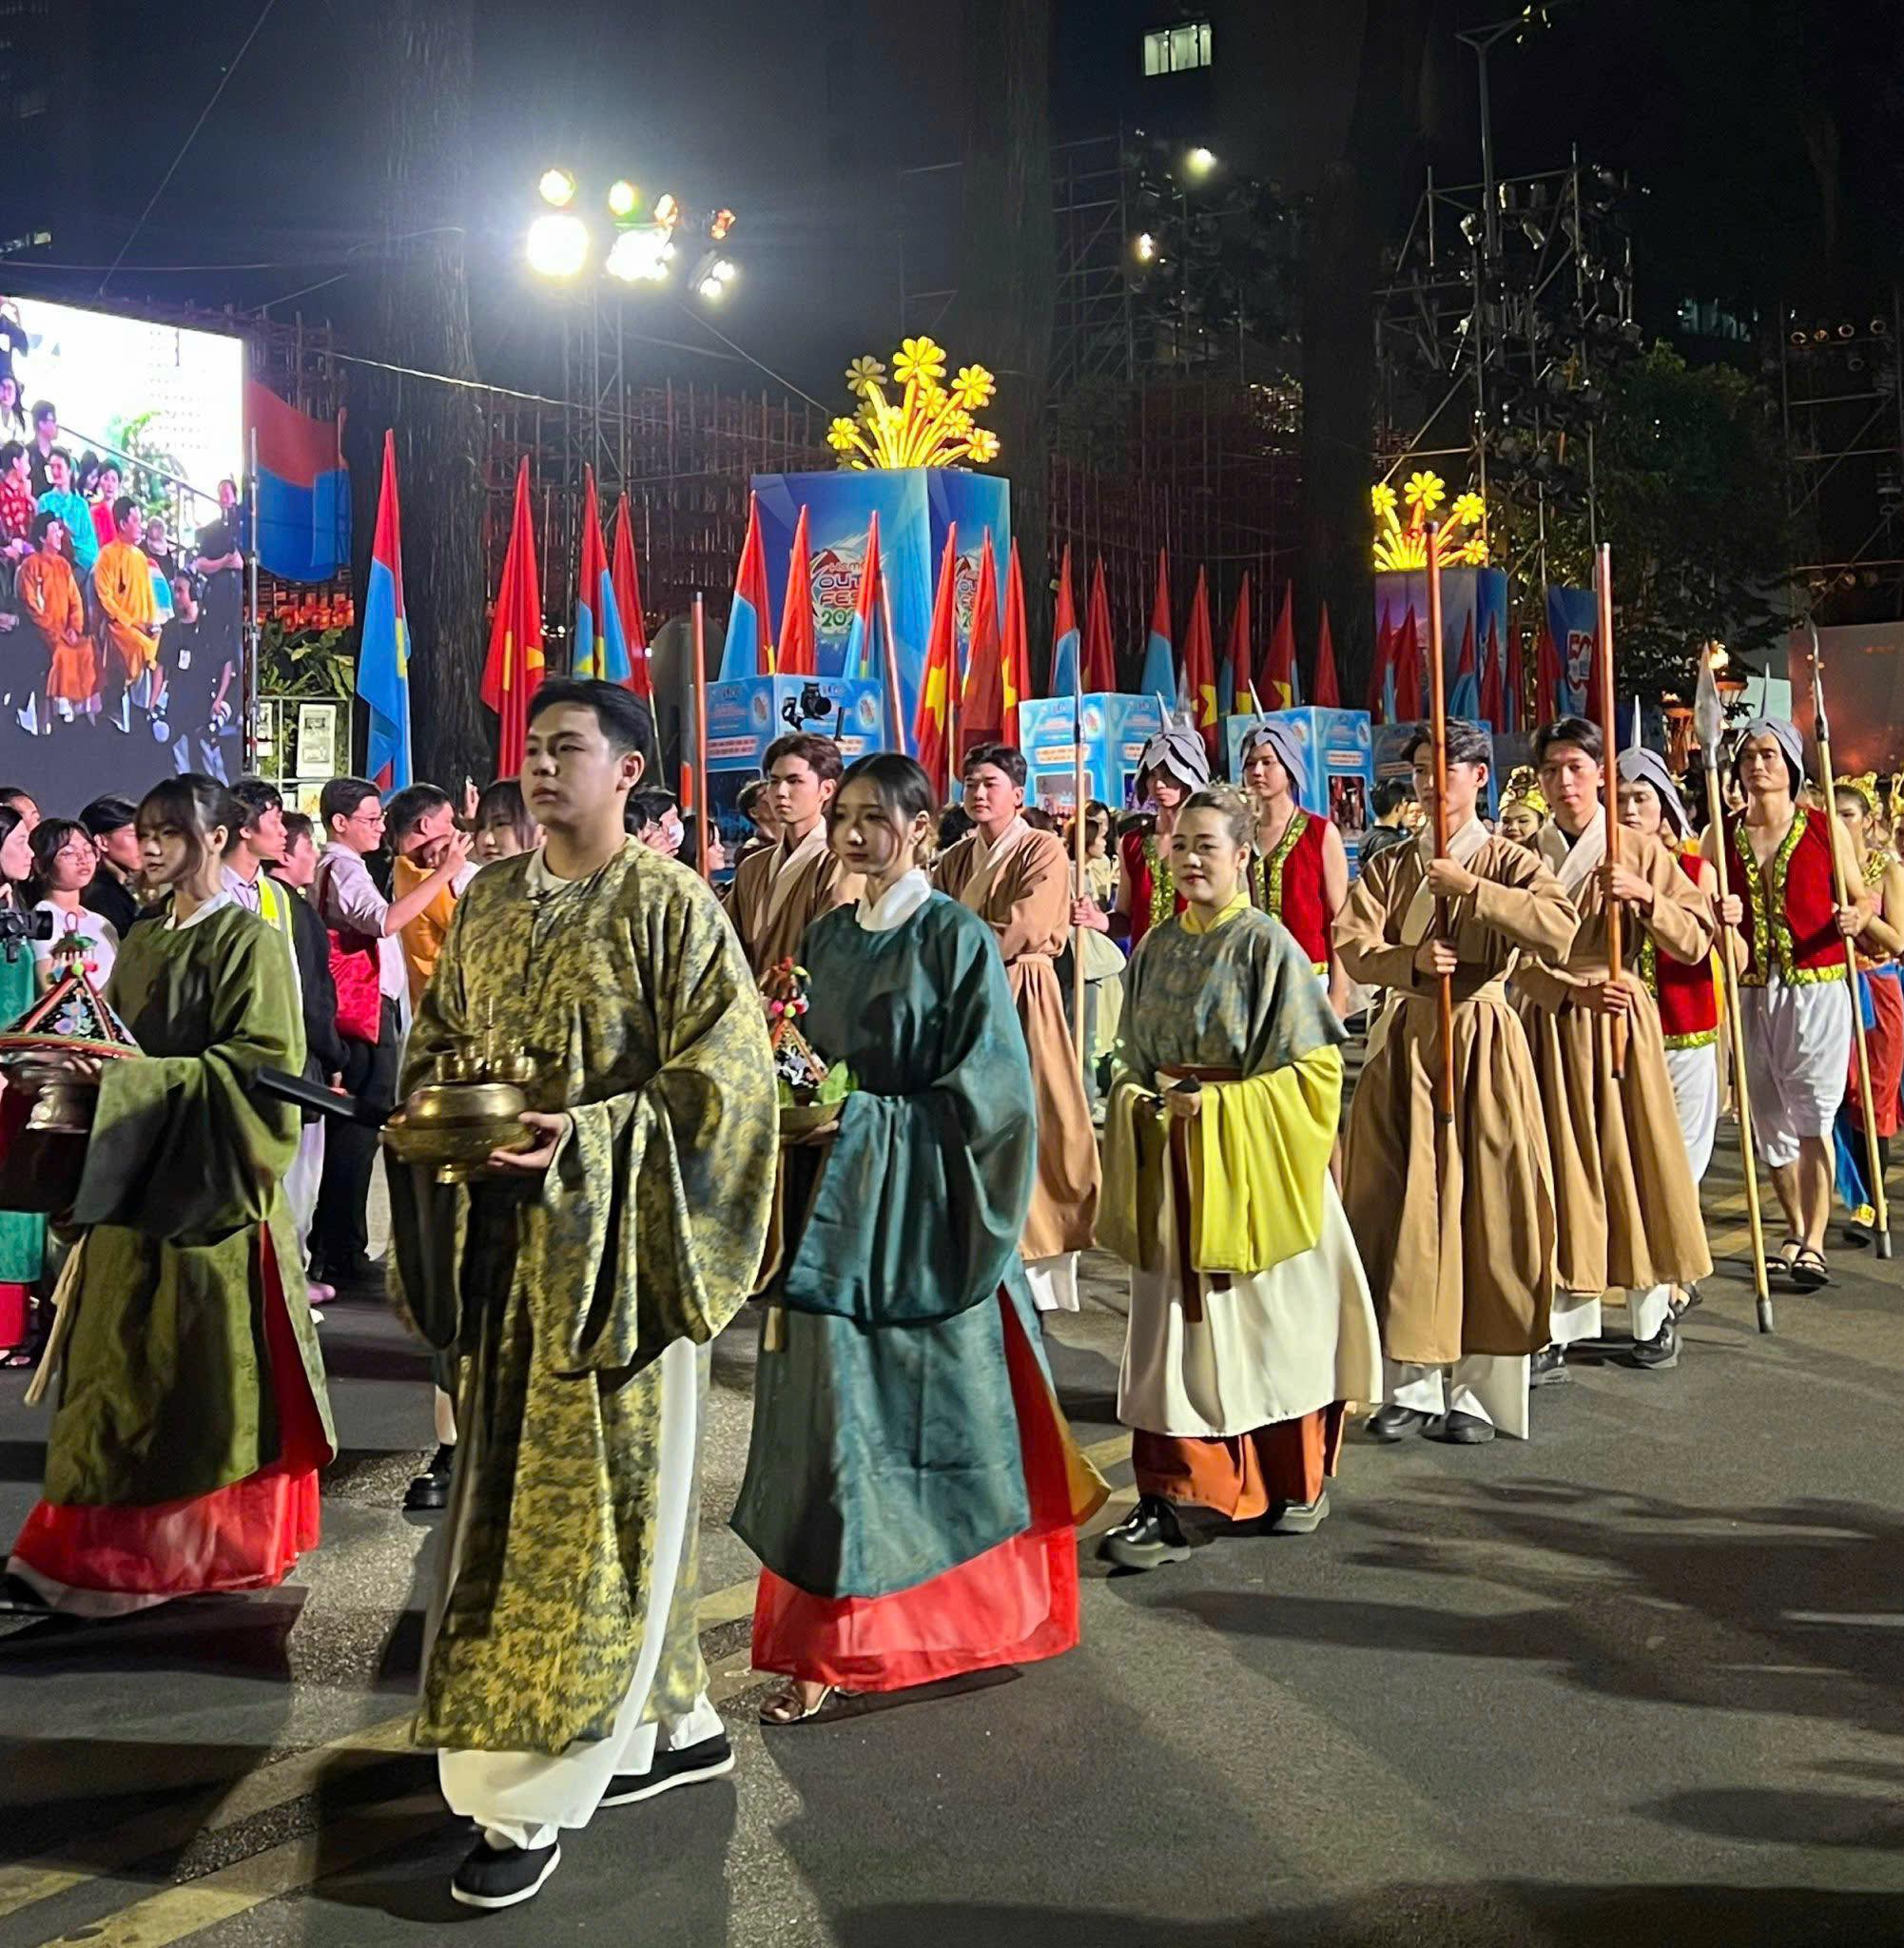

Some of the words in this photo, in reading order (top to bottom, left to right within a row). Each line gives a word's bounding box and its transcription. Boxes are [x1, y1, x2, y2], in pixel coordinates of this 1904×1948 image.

[819, 575, 862, 588] OUT
[820, 591, 859, 606] FES
[821, 610, 855, 628] 202
